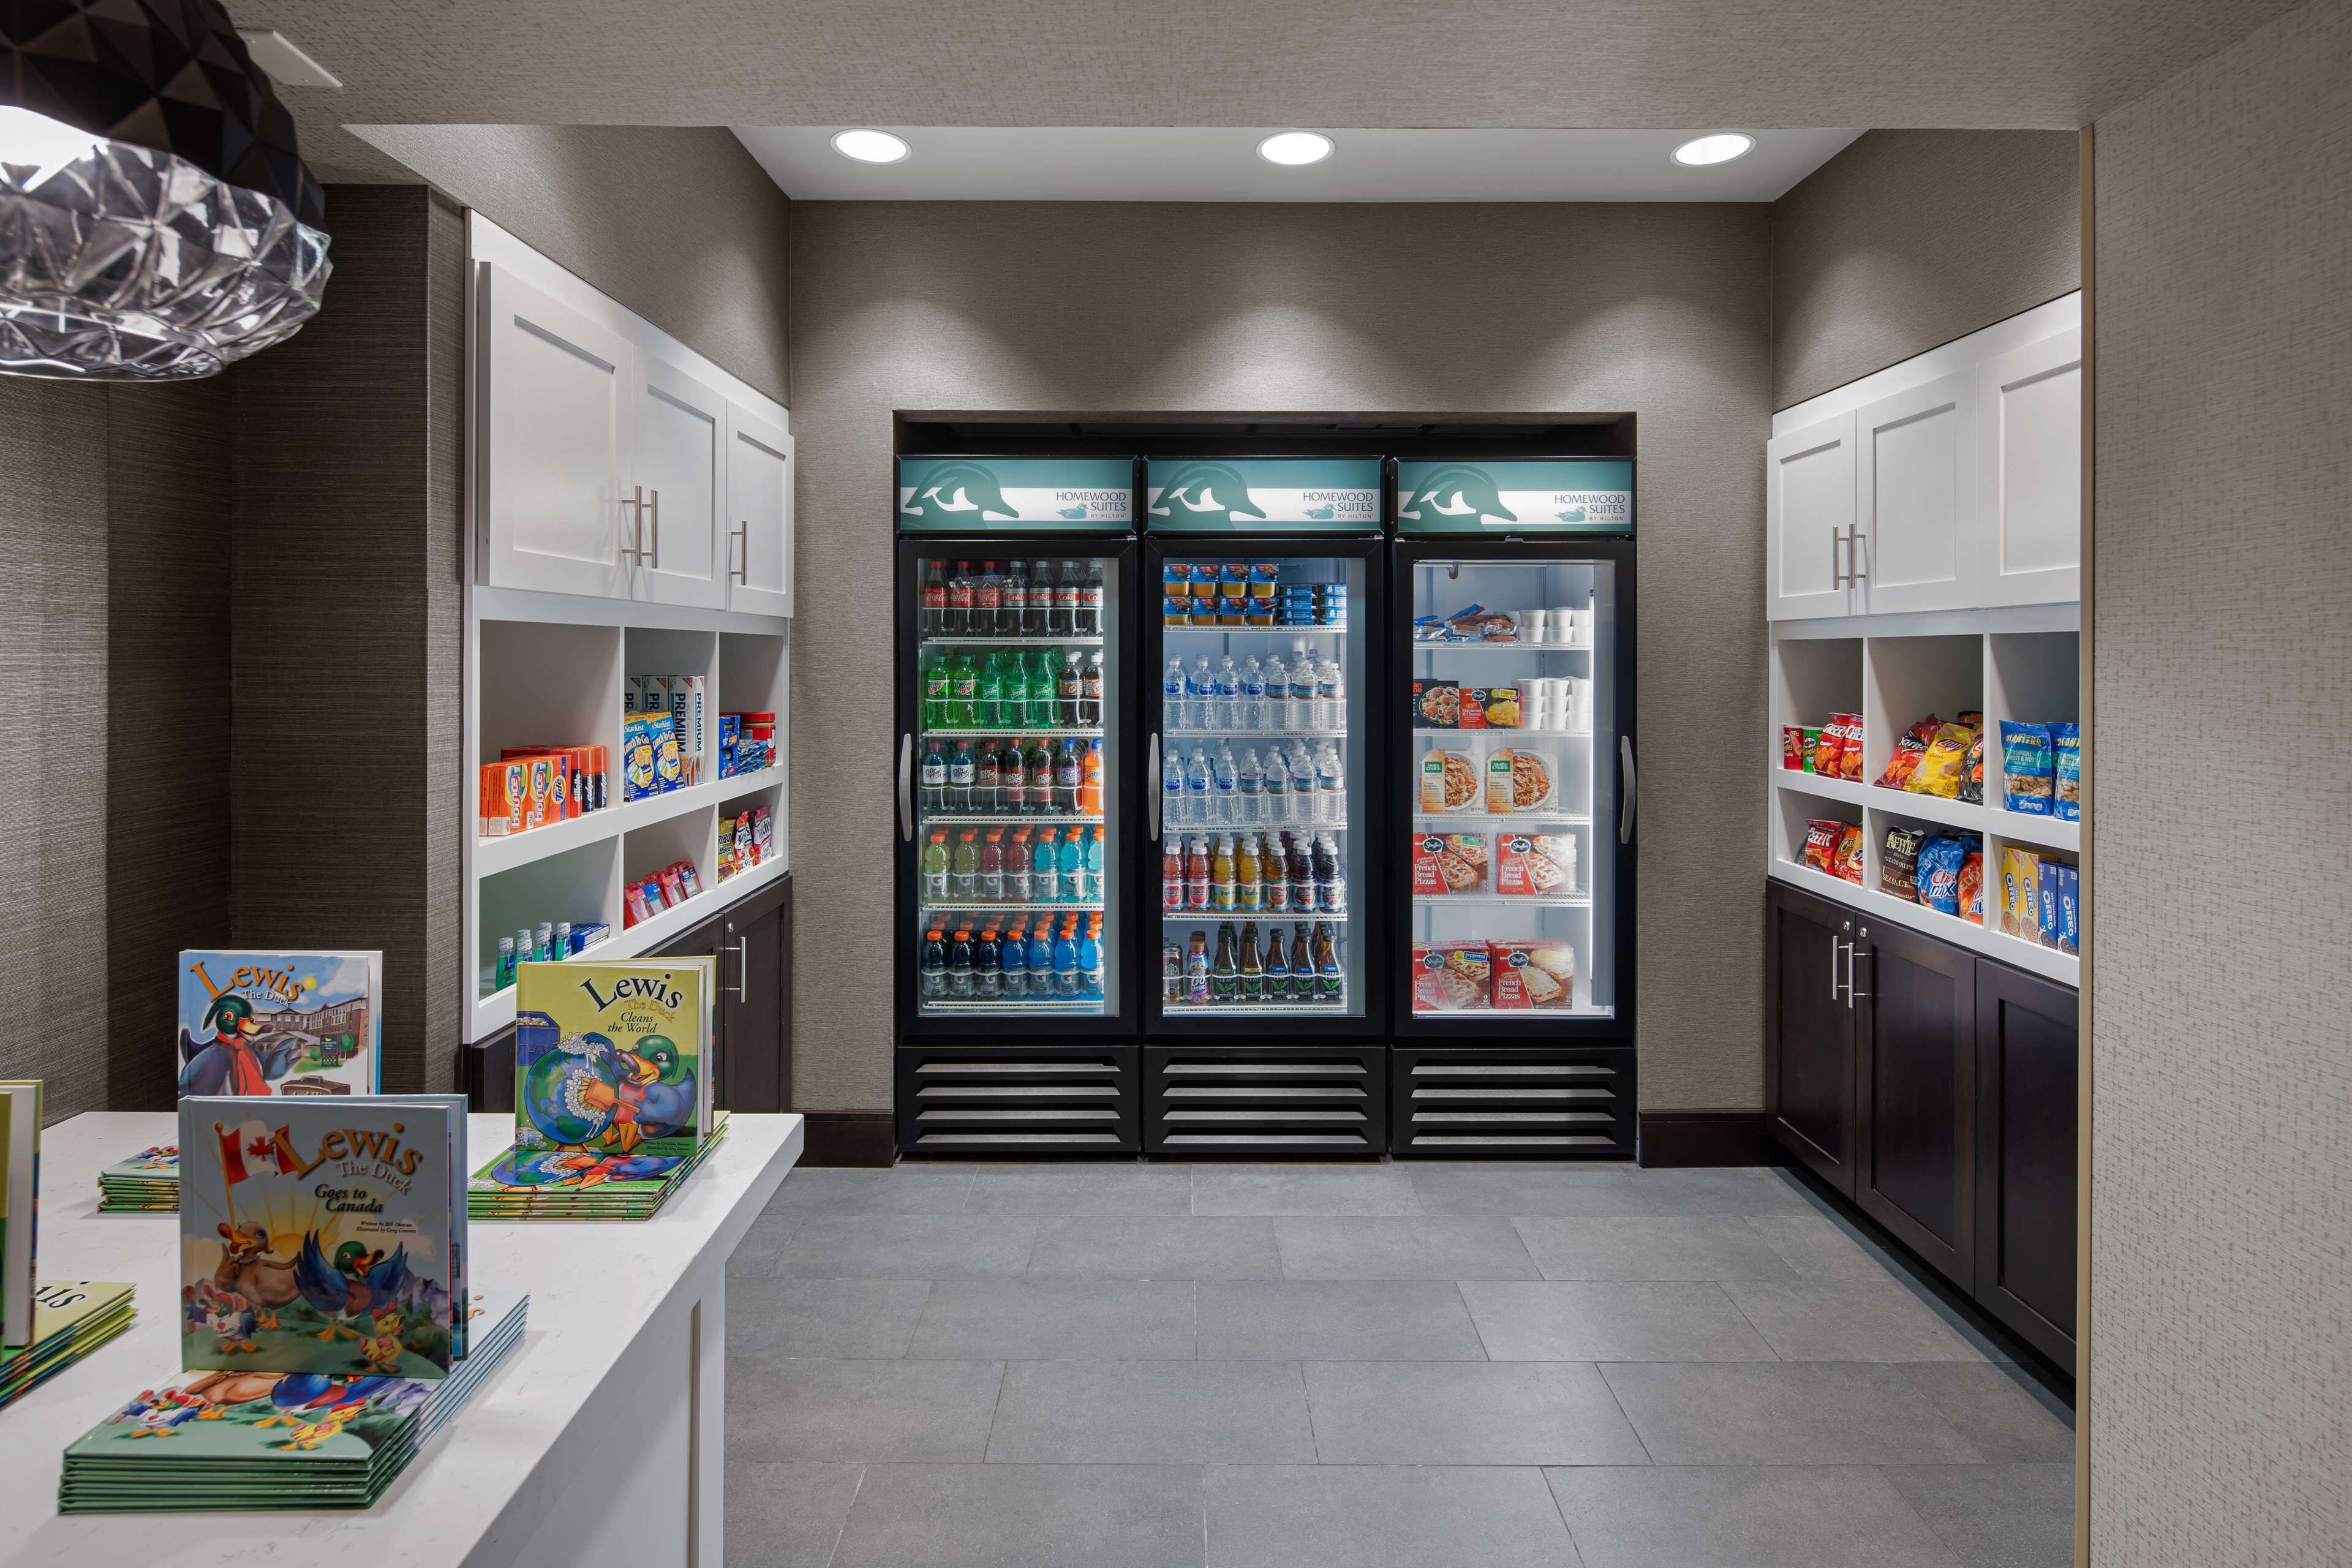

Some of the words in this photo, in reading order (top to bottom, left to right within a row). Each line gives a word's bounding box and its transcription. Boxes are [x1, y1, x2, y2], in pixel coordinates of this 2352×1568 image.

[1057, 492, 1126, 501] HOMEWOOD
[1303, 492, 1373, 501] HOMEWOOD
[1555, 494, 1625, 503] HOMEWOOD
[1090, 502, 1126, 511] SUITES
[1338, 502, 1373, 511] SUITES
[1589, 505, 1625, 514] SUITES
[675, 693, 686, 752] PREMIUM
[625, 737, 636, 754] Lunch
[652, 734, 663, 750] Lunch
[2058, 737, 2079, 747] PLANT
[510, 775, 520, 829] bounce
[533, 771, 545, 823] bounce
[718, 832, 731, 845] RIBO
[1886, 831, 1918, 856] KETTLE
[1899, 862, 1915, 871] CHIPS
[1882, 875, 1891, 884] SEA
[1891, 878, 1908, 888] SALT
[2005, 872, 2015, 911] OREO
[2024, 877, 2034, 916] OREO
[2043, 889, 2053, 930] OREO
[2063, 895, 2073, 937] OREO
[190, 960, 304, 1003] Lewis
[242, 989, 262, 1000] The
[265, 990, 291, 1008] Duck
[579, 973, 683, 1012] Lewis
[620, 1012, 654, 1023] Cleans
[624, 998, 645, 1011] The
[647, 1000, 676, 1023] Duck
[608, 1022, 624, 1033] the
[626, 1022, 657, 1034] World
[268, 1122, 423, 1181] Lewis
[336, 1161, 366, 1177] The
[372, 1163, 411, 1195] Duck
[315, 1183, 348, 1200] Goes
[353, 1188, 367, 1199] to
[325, 1197, 383, 1213] Canada
